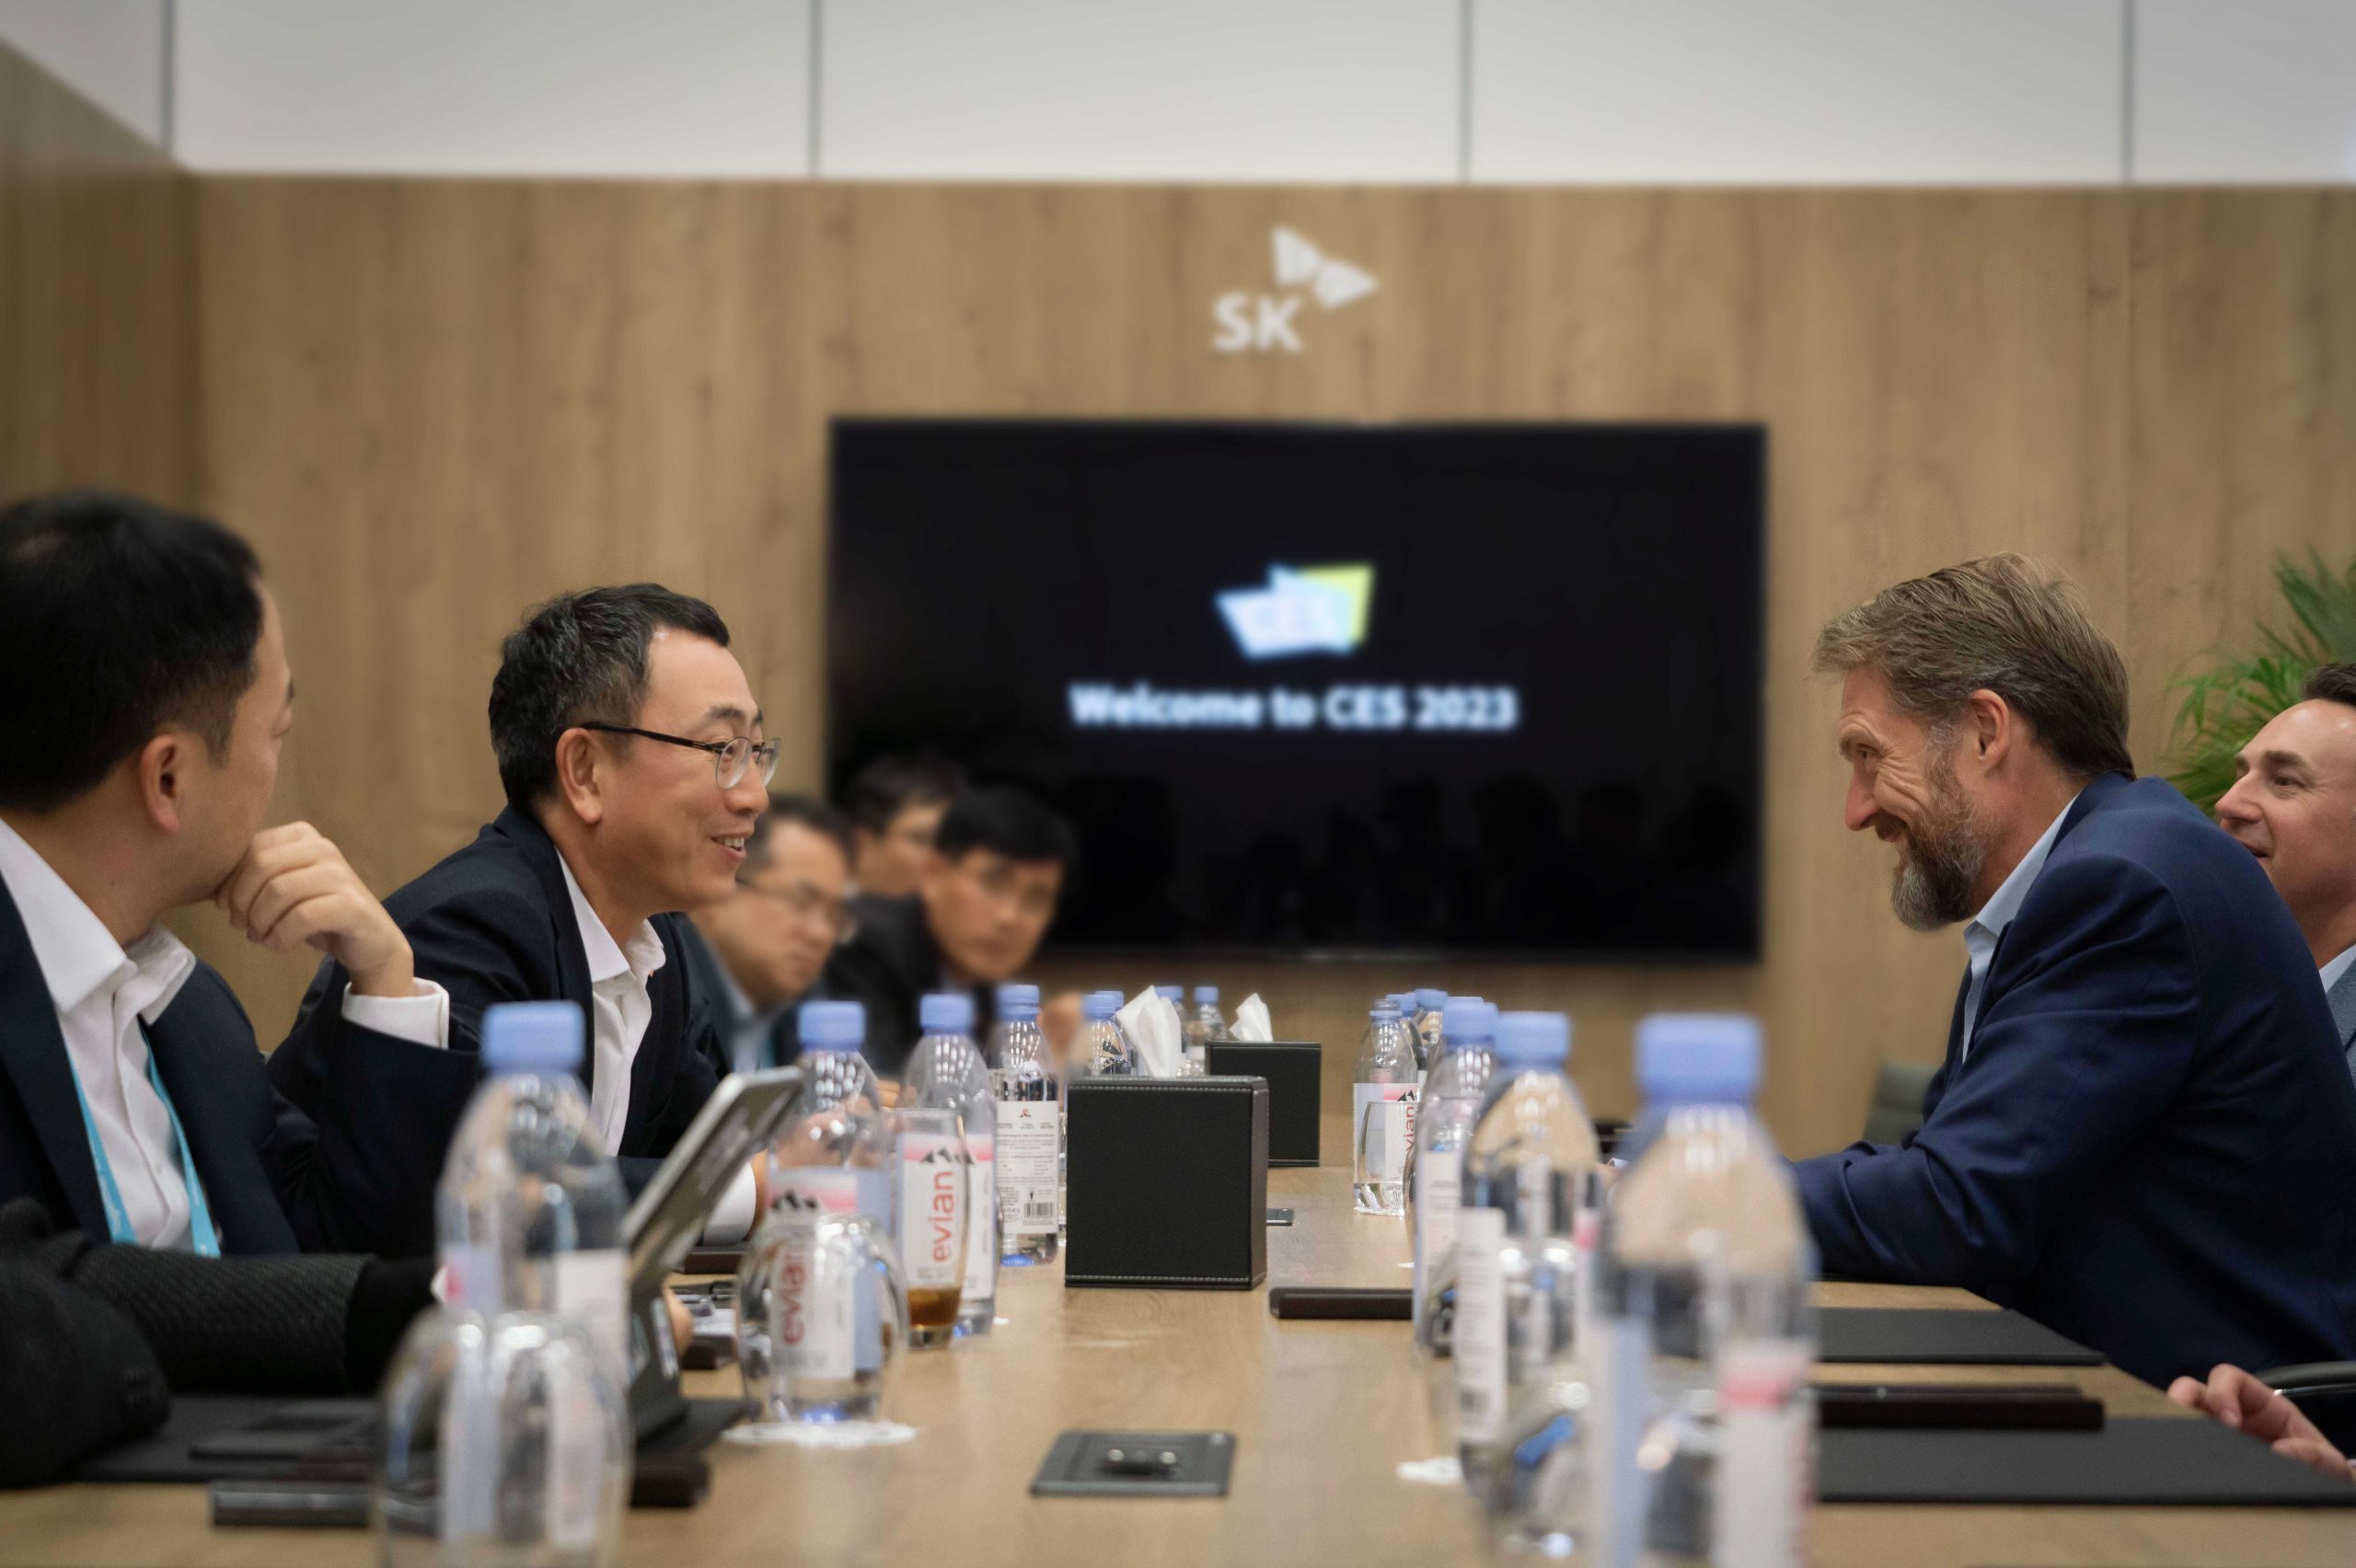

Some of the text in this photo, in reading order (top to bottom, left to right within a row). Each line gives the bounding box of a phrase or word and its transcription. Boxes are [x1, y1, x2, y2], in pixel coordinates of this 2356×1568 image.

[1212, 291, 1305, 352] SK
[1068, 683, 1519, 731] Welcome to CES 2023
[928, 1170, 955, 1264] evian
